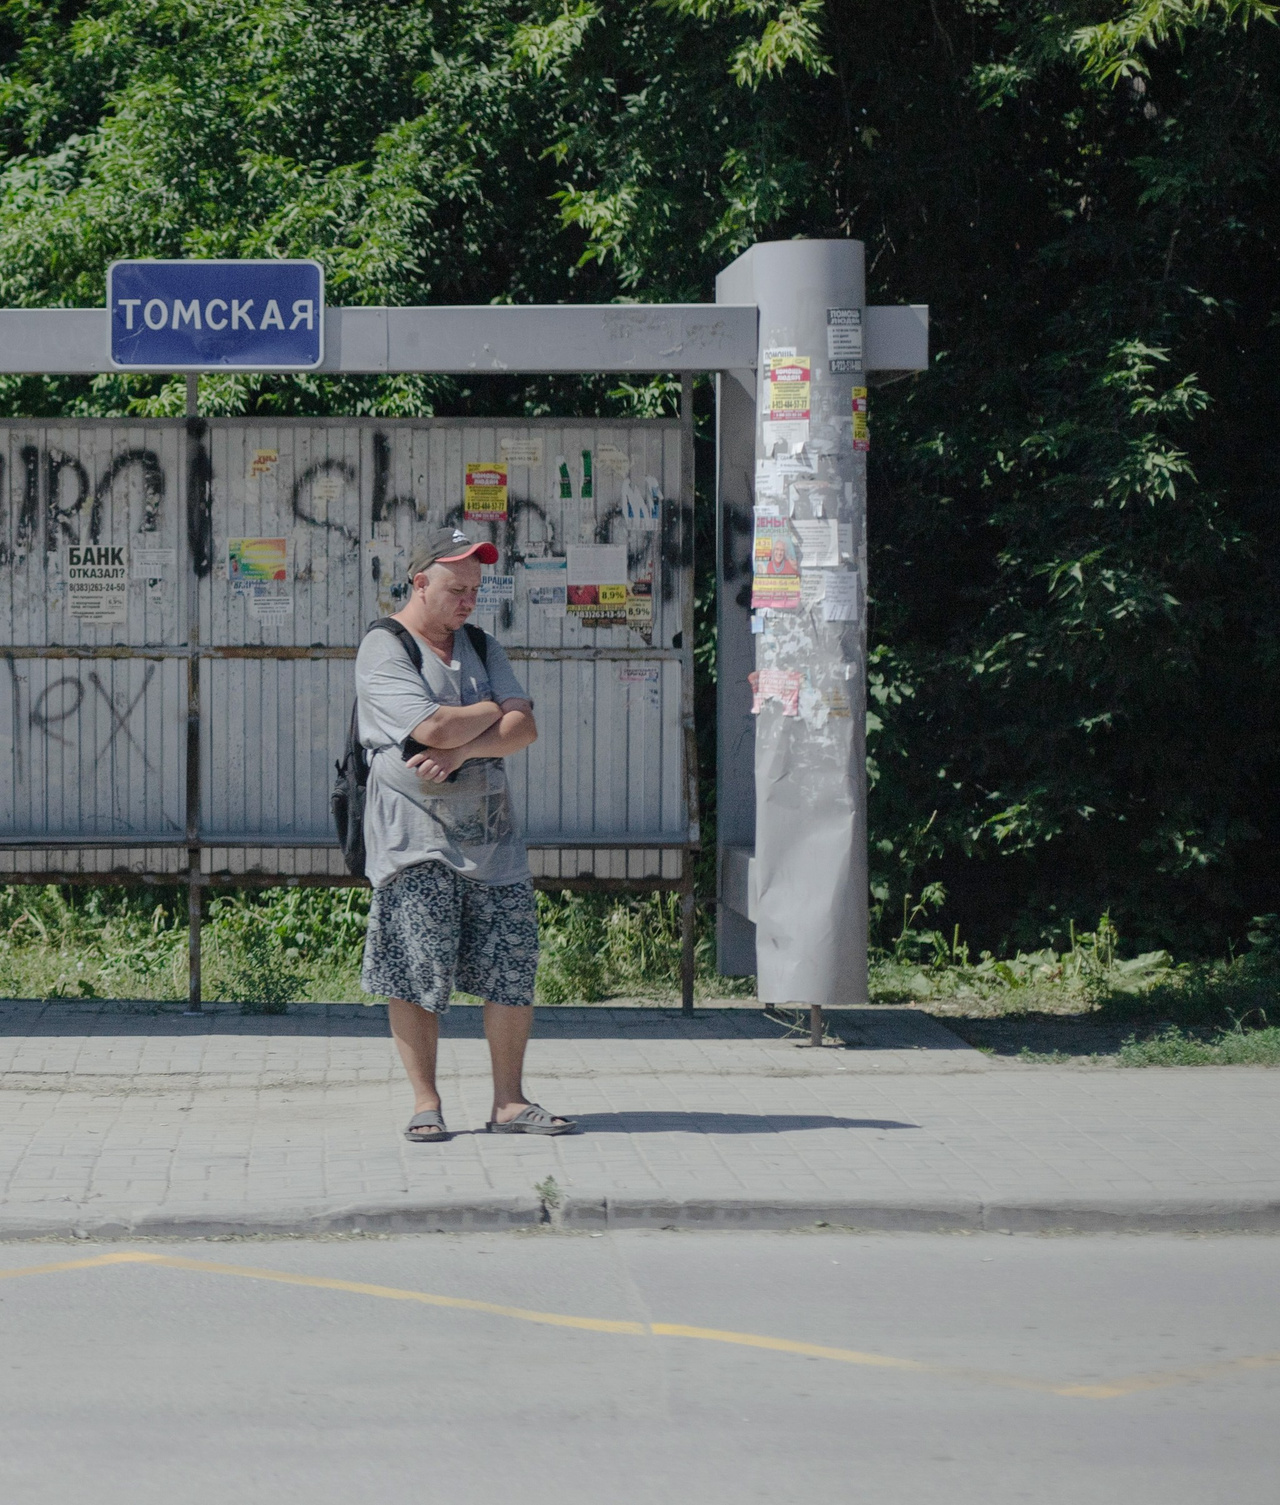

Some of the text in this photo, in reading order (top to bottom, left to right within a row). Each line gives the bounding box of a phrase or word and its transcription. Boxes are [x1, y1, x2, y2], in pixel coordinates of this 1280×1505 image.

[118, 298, 314, 331] ТОМСКАЯ
[69, 547, 124, 566] БАНК
[69, 568, 125, 579] ОТКАЗАЛ?
[69, 583, 126, 593] 8(383)263-24-50
[601, 591, 624, 600] 8,9%
[628, 607, 650, 616] 8,9%
